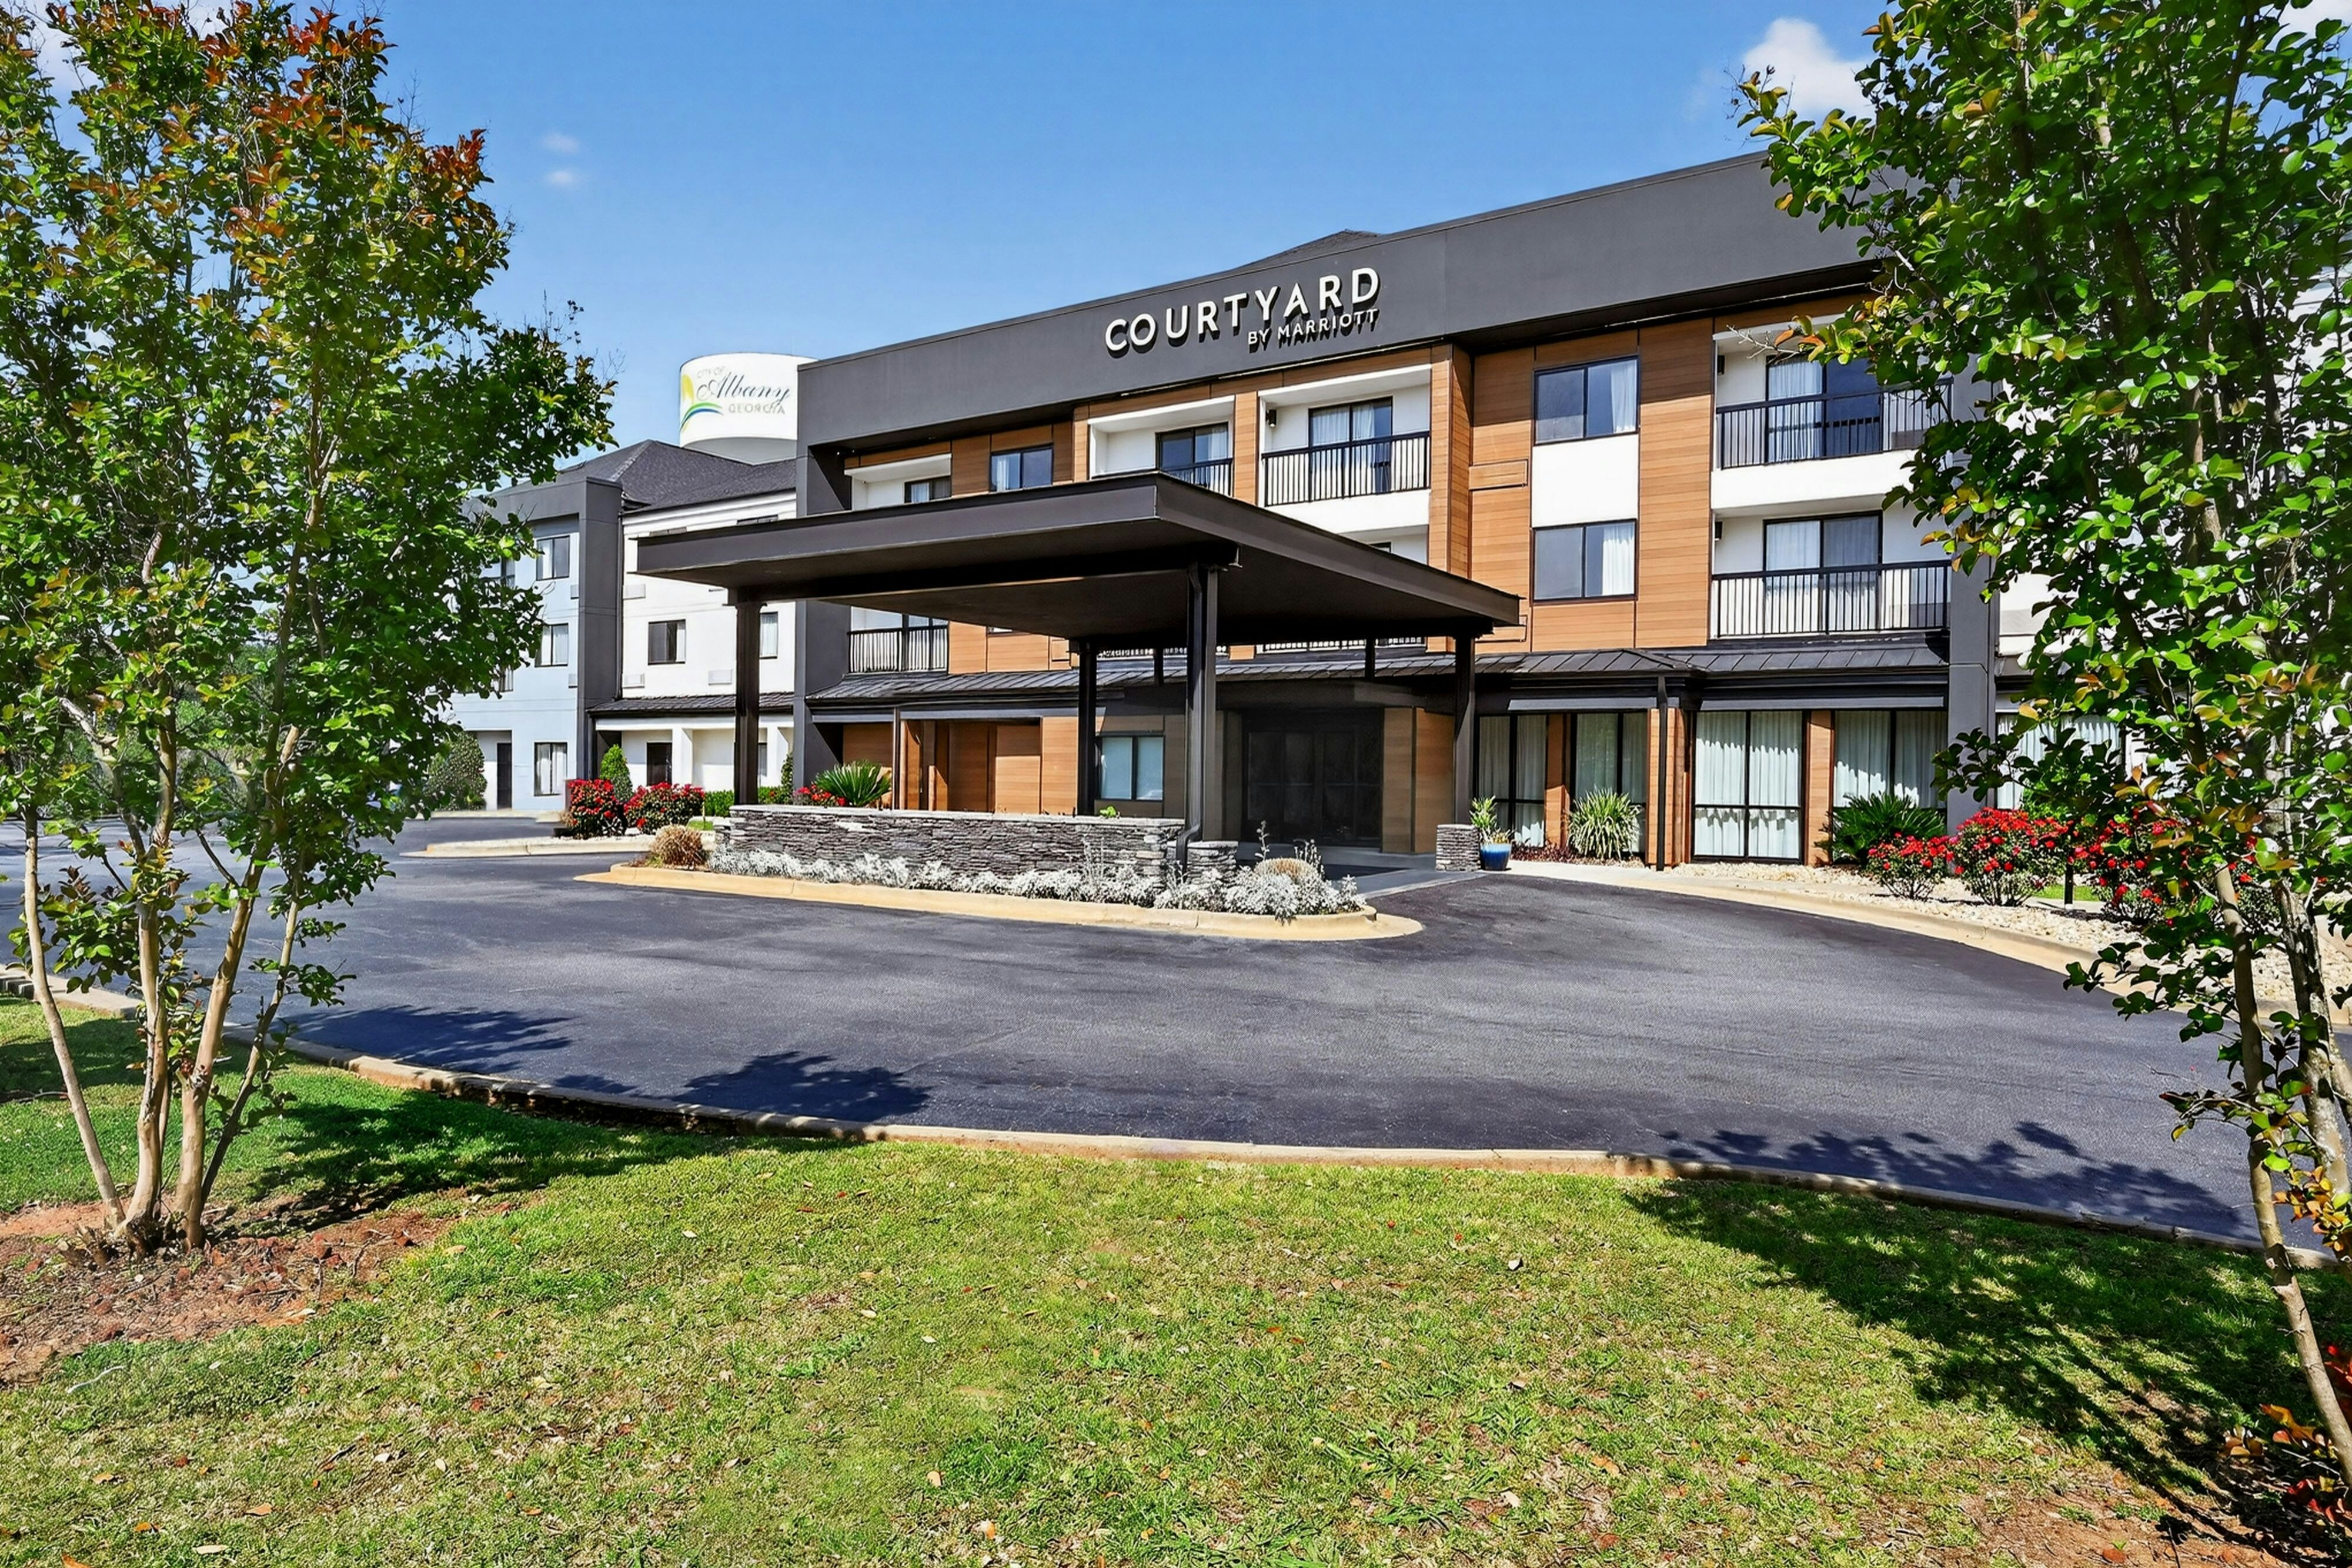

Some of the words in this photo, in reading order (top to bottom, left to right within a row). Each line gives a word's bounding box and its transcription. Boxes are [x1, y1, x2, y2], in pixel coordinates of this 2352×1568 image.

[1105, 268, 1379, 351] COURTYARD
[1248, 327, 1269, 345] BY
[1278, 309, 1379, 340] MARRIOTT
[696, 372, 790, 406] Albany
[728, 403, 785, 414] GEORGIA
